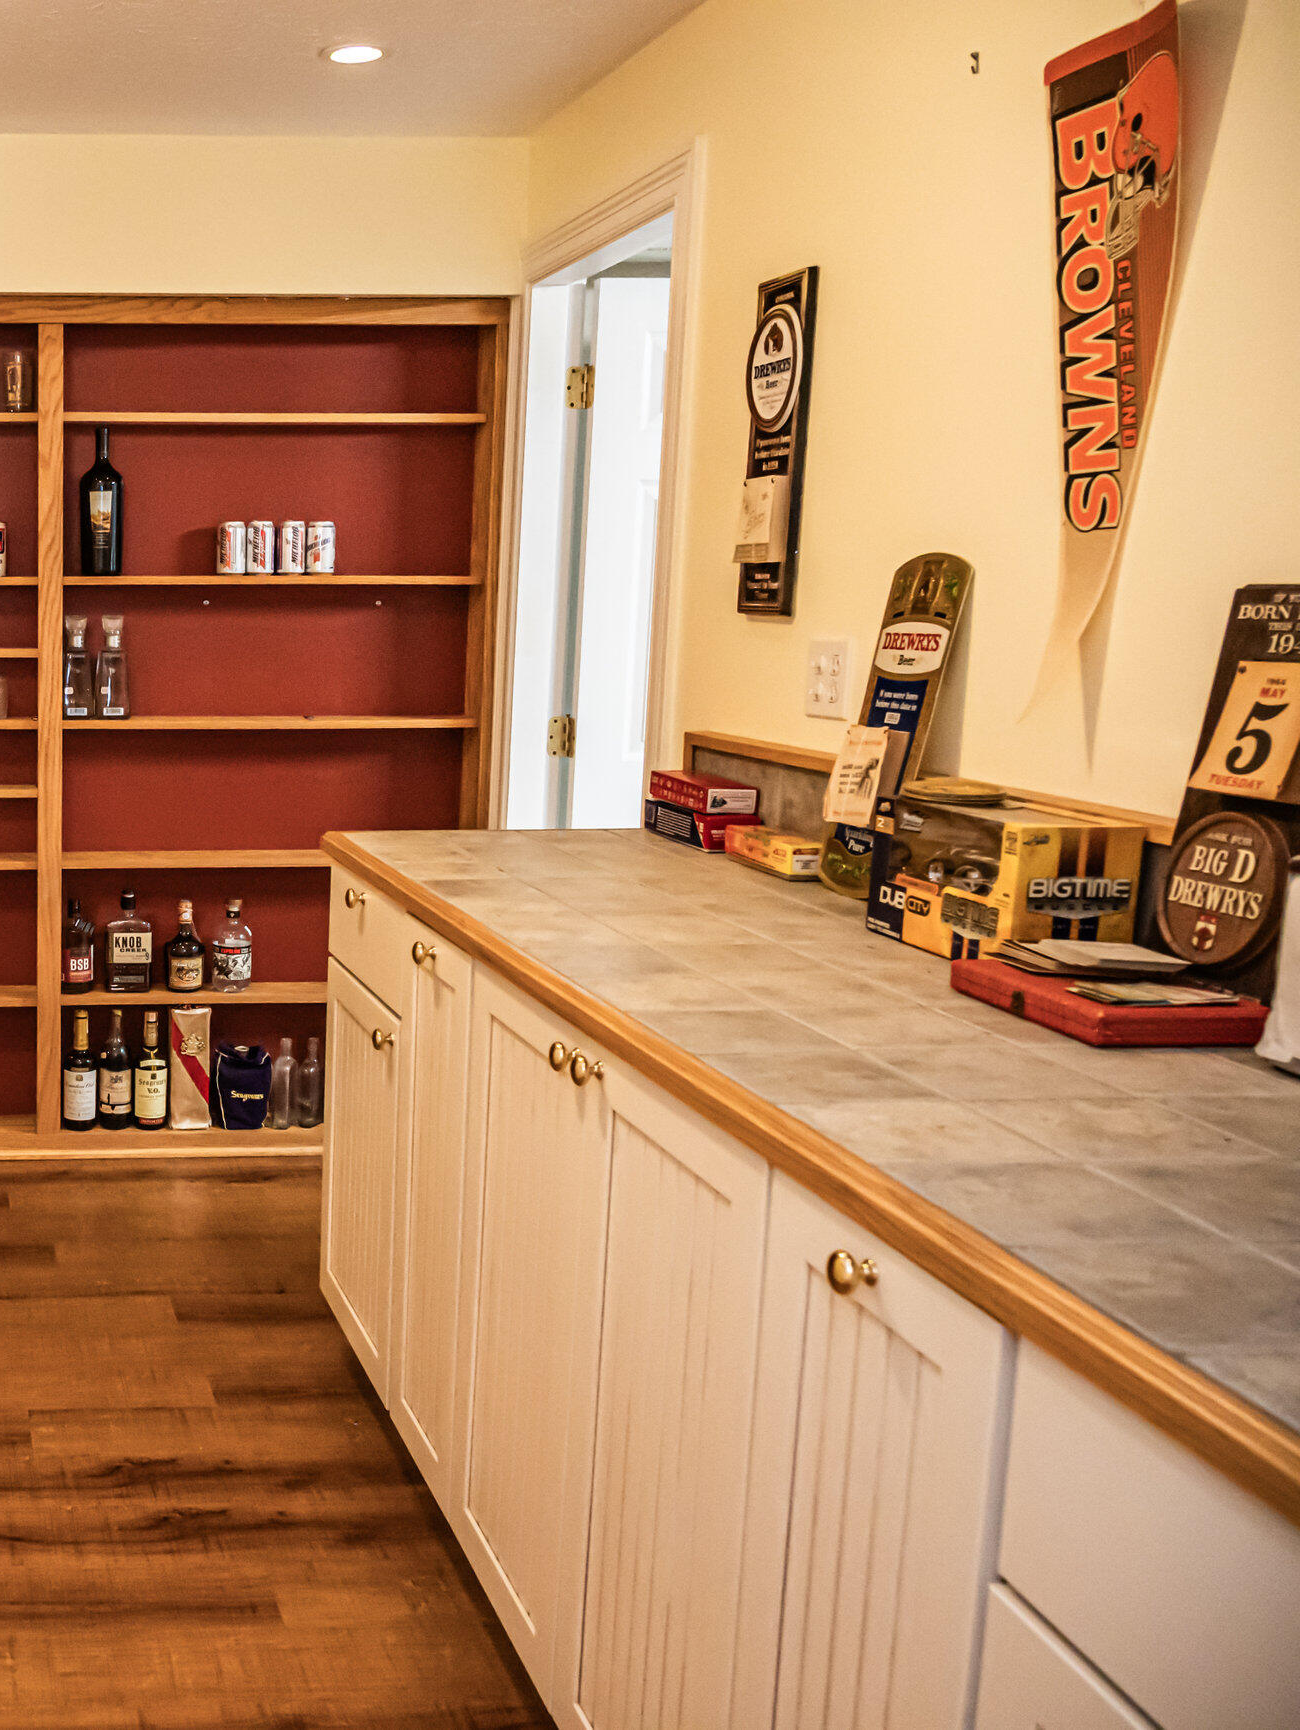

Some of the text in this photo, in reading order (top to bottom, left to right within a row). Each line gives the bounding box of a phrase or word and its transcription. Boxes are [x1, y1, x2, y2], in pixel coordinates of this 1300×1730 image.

[1055, 97, 1122, 532] BROWNS
[1116, 258, 1137, 449] CLEVELAND
[754, 358, 792, 380] DREWRYS
[1238, 604, 1293, 620] BORN
[882, 633, 942, 652] DREWRYS
[1260, 688, 1286, 699] MAY
[1226, 701, 1290, 775] 5
[1209, 774, 1266, 790] TUESDAY
[1189, 844, 1257, 884] BIG D
[879, 885, 906, 910] DUB
[1028, 878, 1132, 898] BIGTIME
[1167, 874, 1263, 920] DREWRYS
[114, 936, 142, 948] KNOB
[70, 958, 89, 971] BSB
